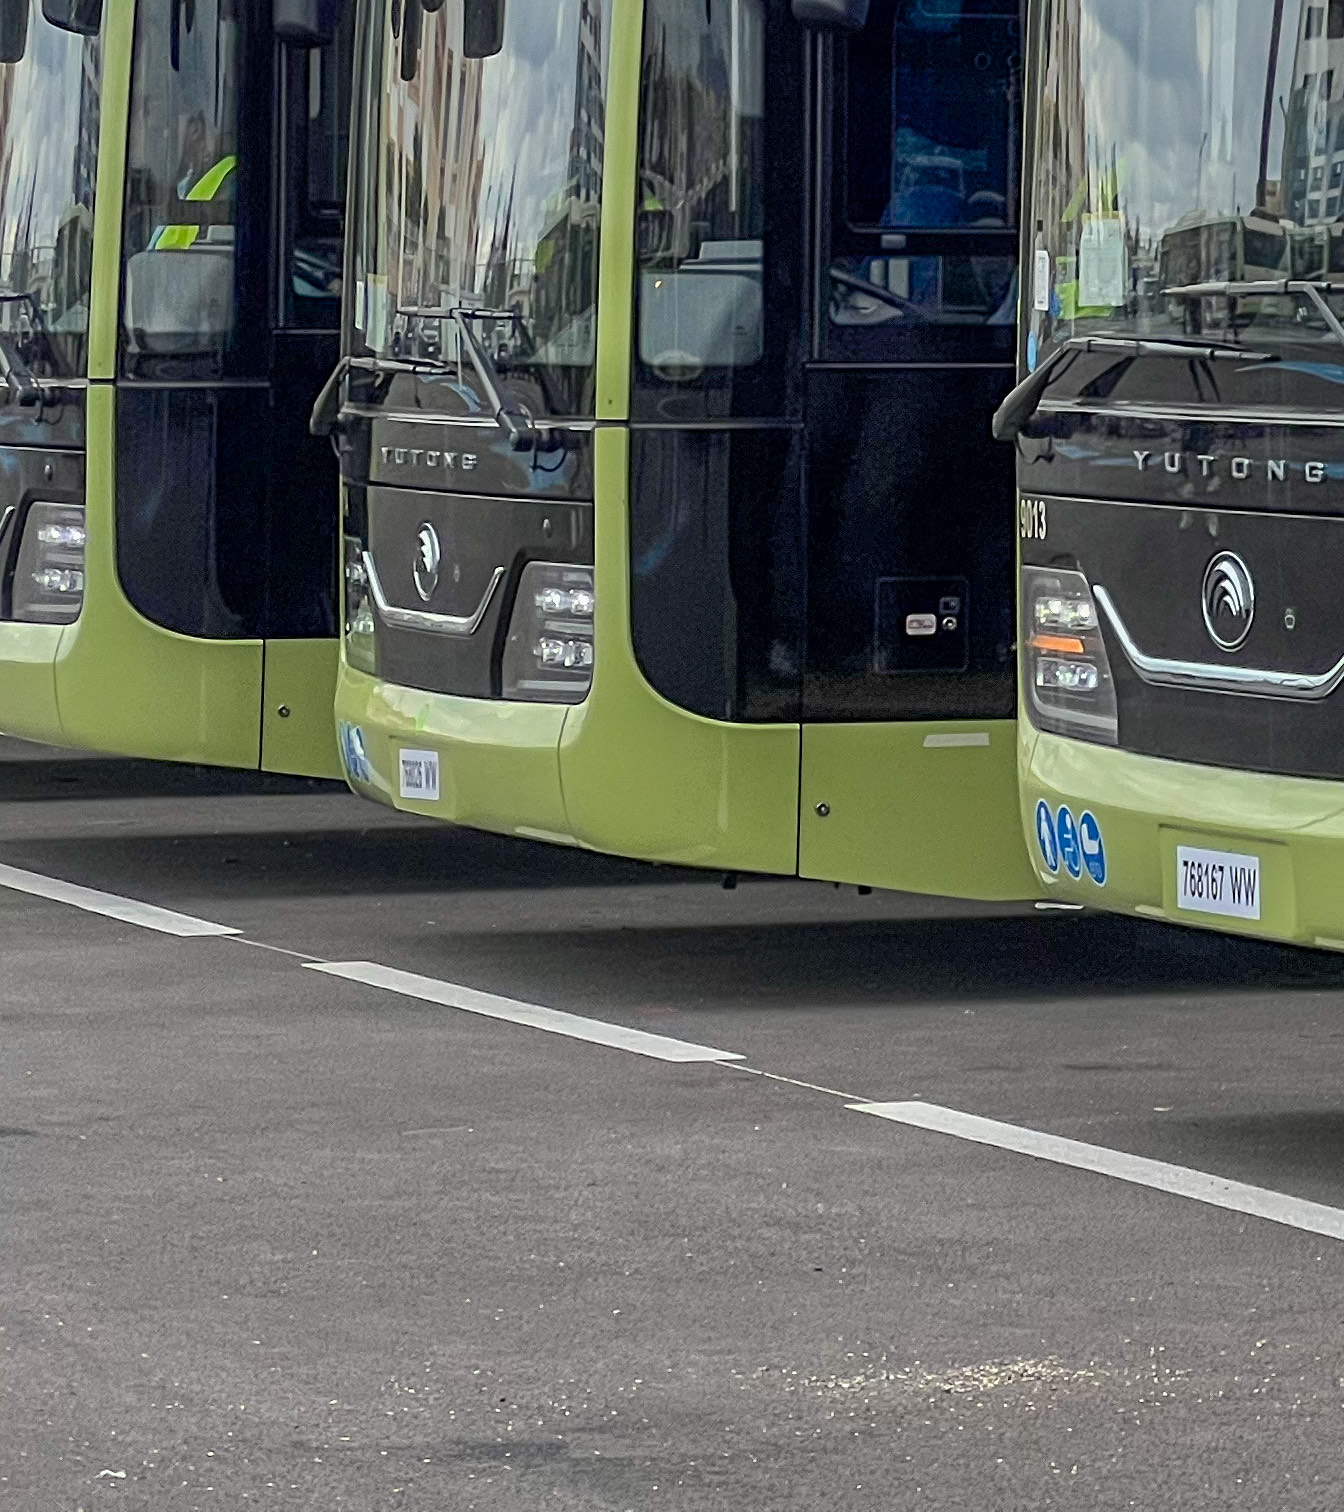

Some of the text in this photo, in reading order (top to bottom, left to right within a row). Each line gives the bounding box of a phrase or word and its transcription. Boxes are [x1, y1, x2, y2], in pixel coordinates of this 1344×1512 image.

[1133, 450, 1326, 483] YUTONG
[1020, 499, 1047, 540] 9013
[1183, 859, 1257, 907] 768167 WW
